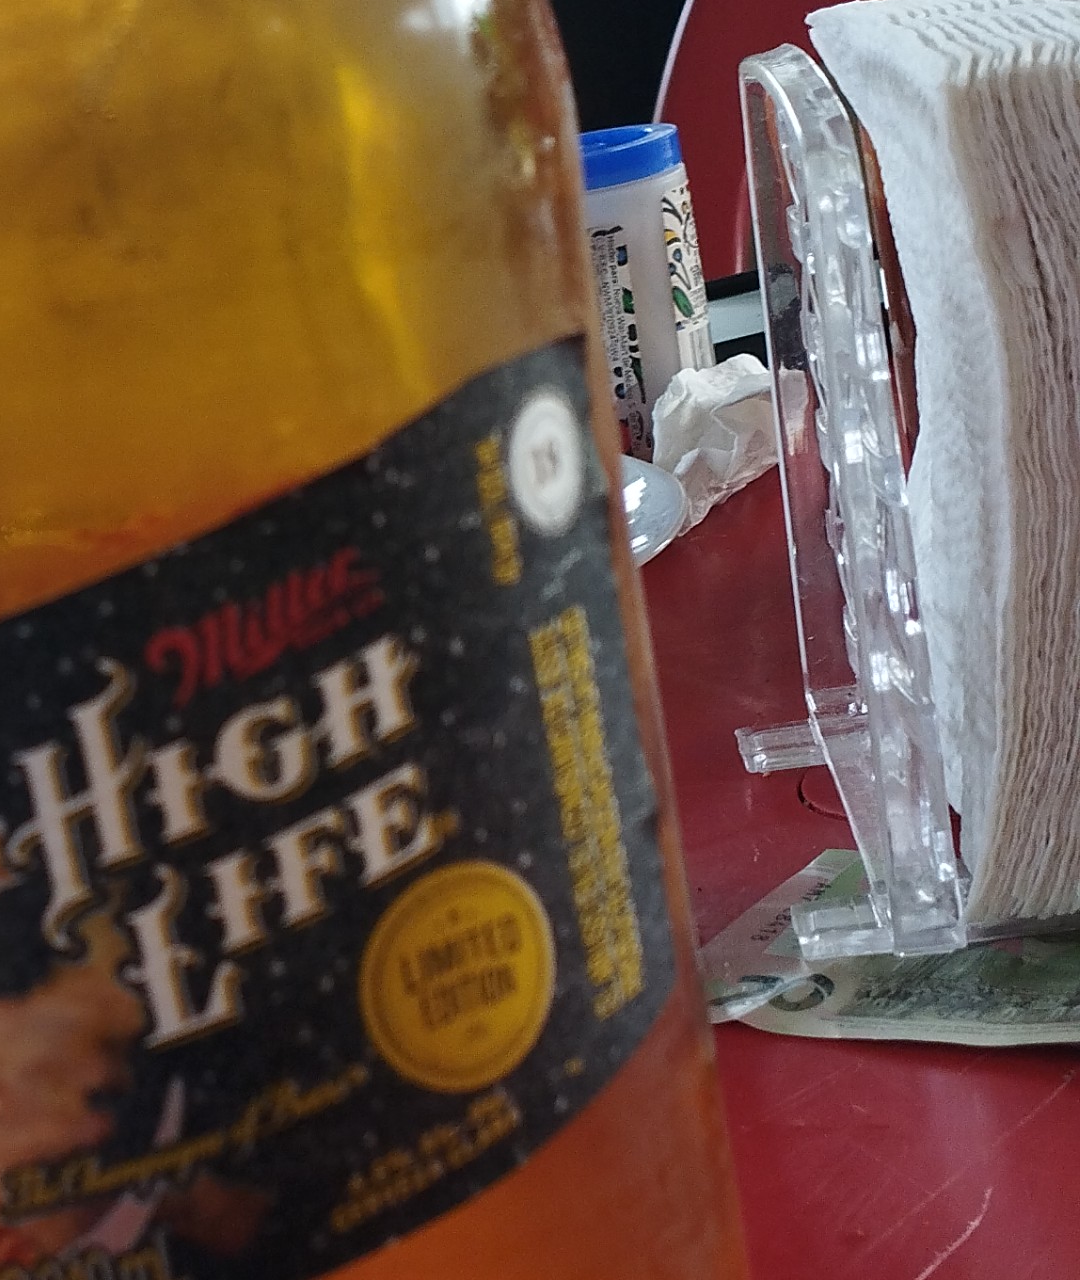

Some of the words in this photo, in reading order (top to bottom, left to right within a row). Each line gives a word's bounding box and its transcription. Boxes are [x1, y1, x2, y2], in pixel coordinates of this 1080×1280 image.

[144, 546, 364, 708] Miller
[7, 633, 419, 951] HIGH
[122, 762, 442, 1049] LIFE
[400, 913, 523, 995] LIMITED
[420, 966, 517, 1031] EDITION
